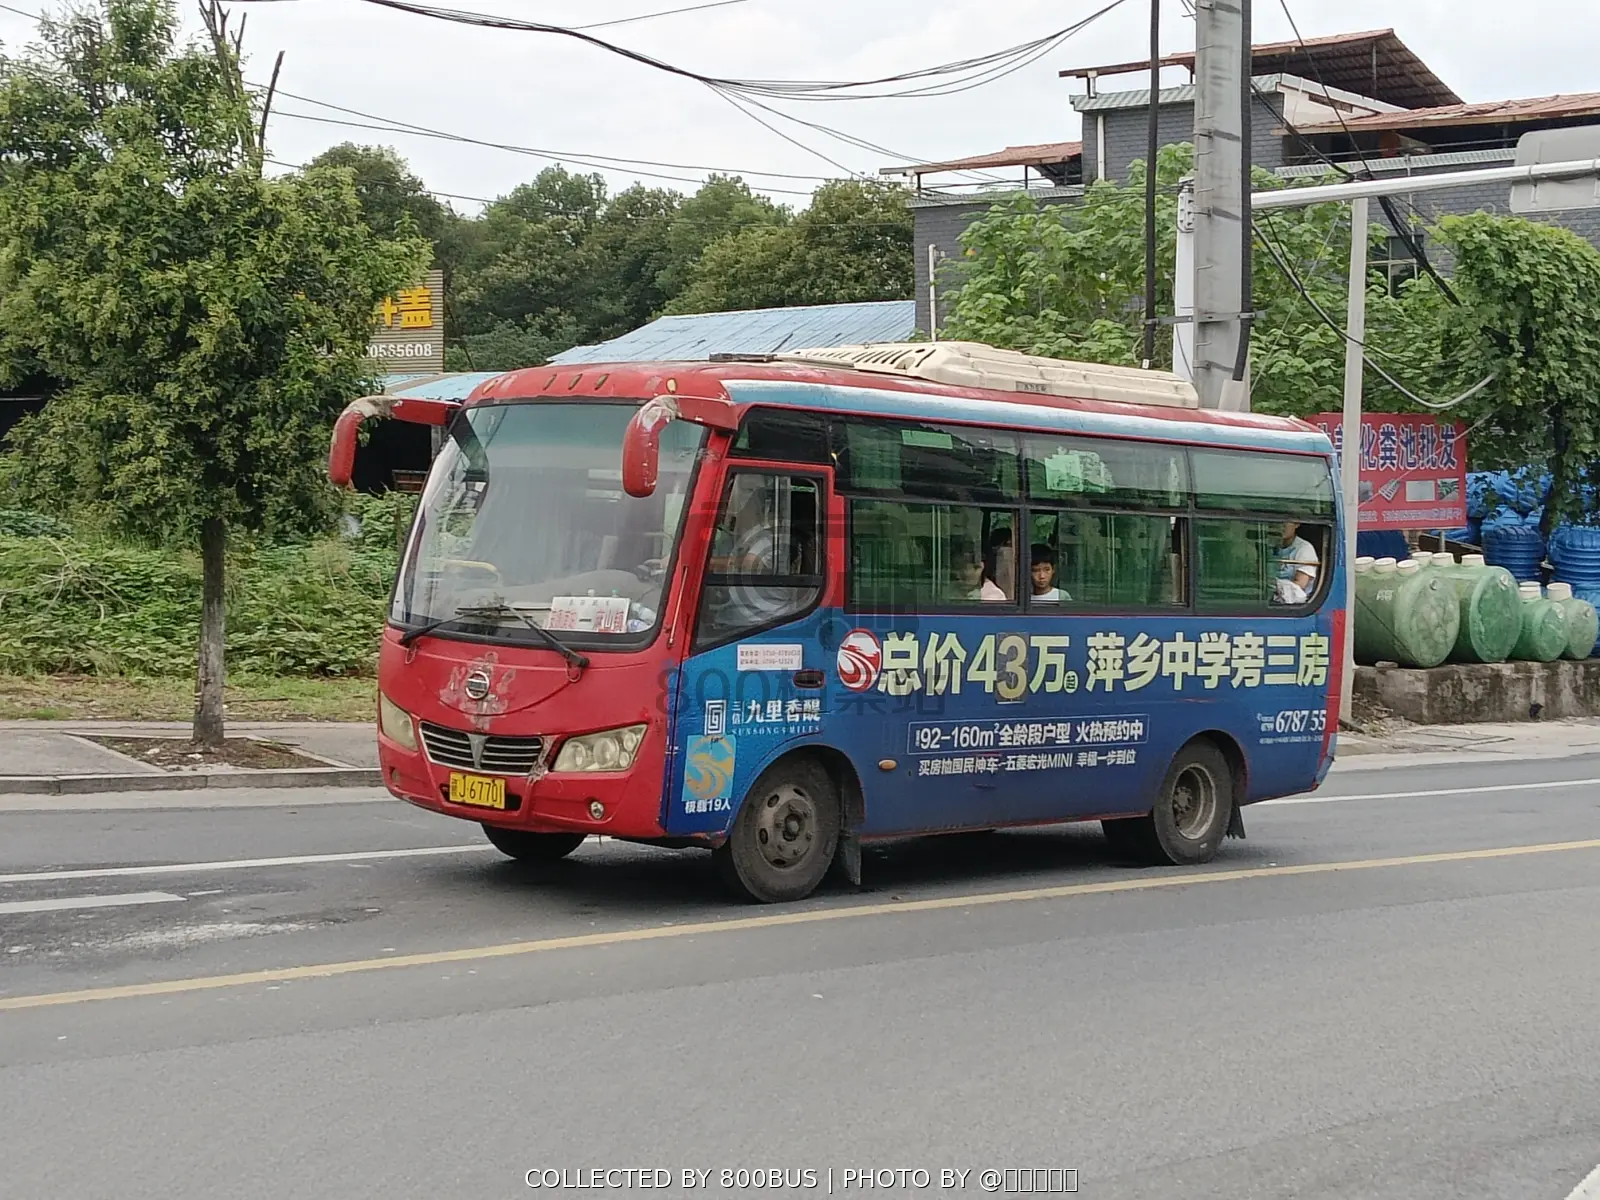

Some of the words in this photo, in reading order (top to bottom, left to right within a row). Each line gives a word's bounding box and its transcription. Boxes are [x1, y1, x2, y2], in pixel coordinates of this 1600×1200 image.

[1085, 631, 1330, 692] 萍乡中学旁三房
